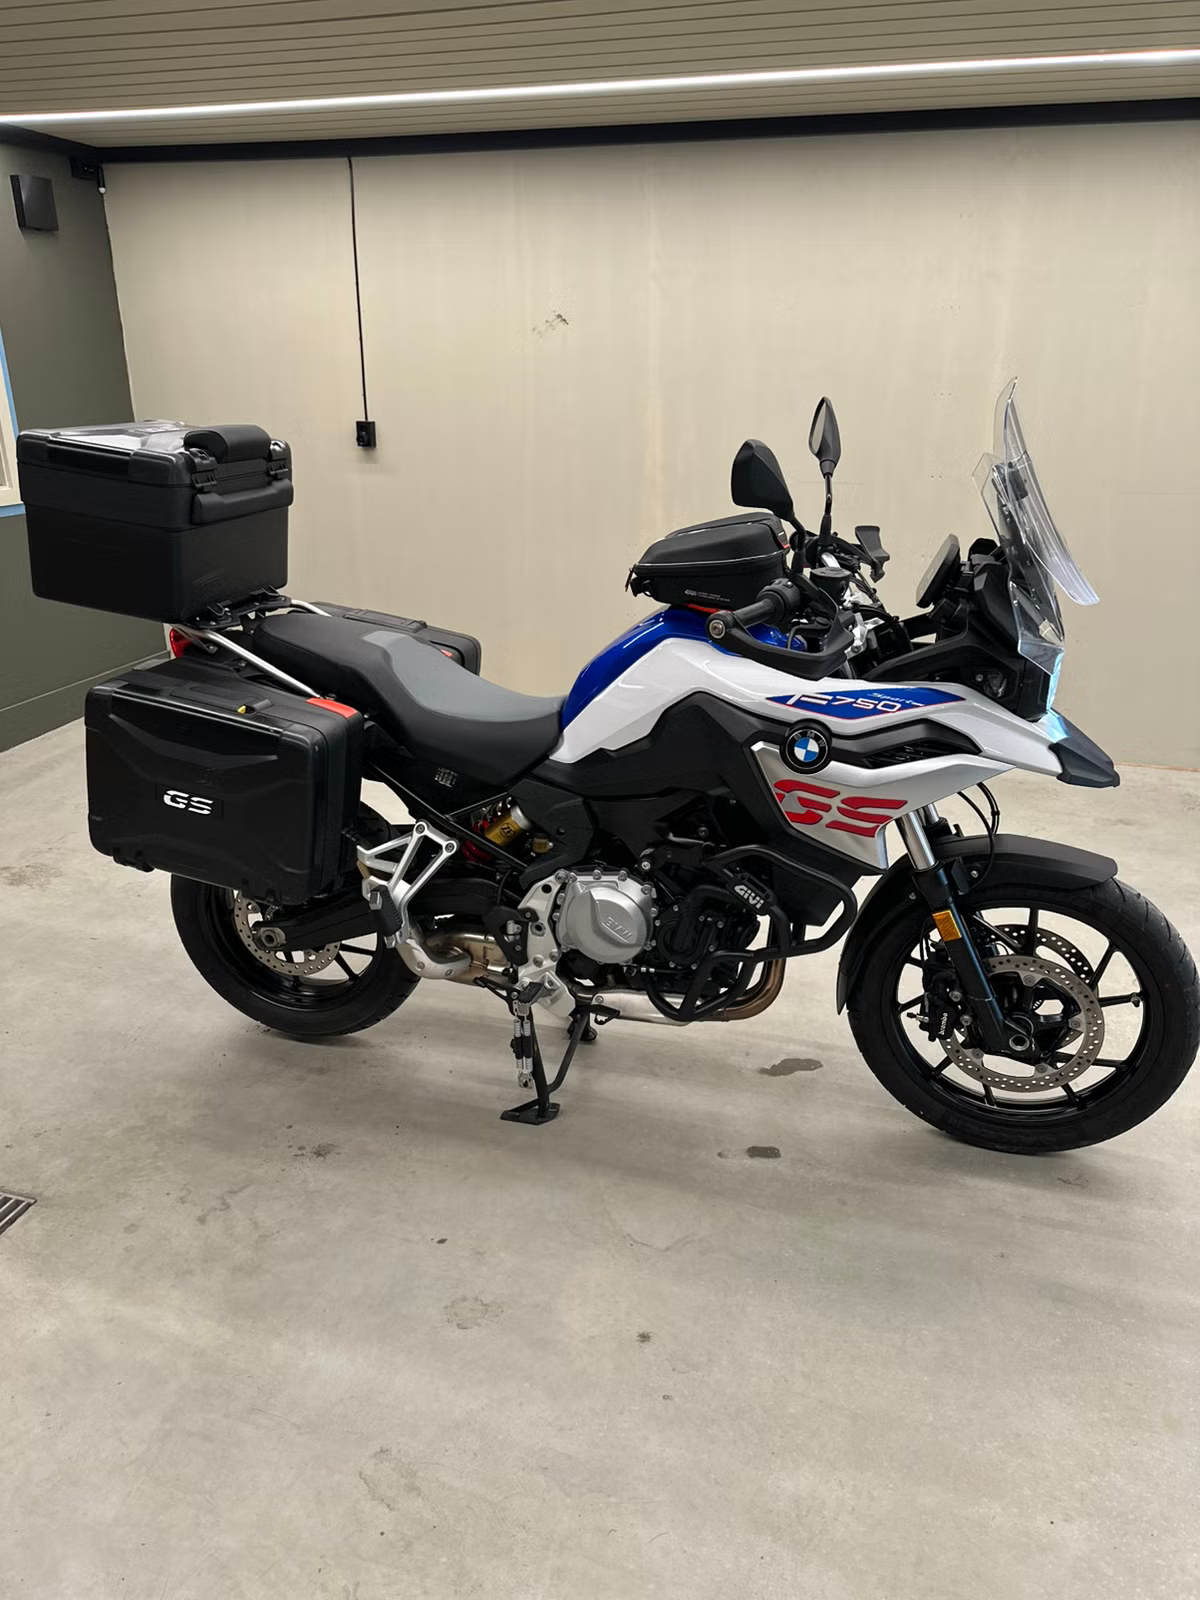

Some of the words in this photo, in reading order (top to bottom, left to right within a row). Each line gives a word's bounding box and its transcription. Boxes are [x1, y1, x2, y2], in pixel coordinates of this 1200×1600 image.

[793, 730, 826, 748] BMW
[163, 789, 214, 815] GS
[773, 778, 908, 838] GS
[734, 884, 765, 910] GIVI
[605, 916, 633, 940] BMW
